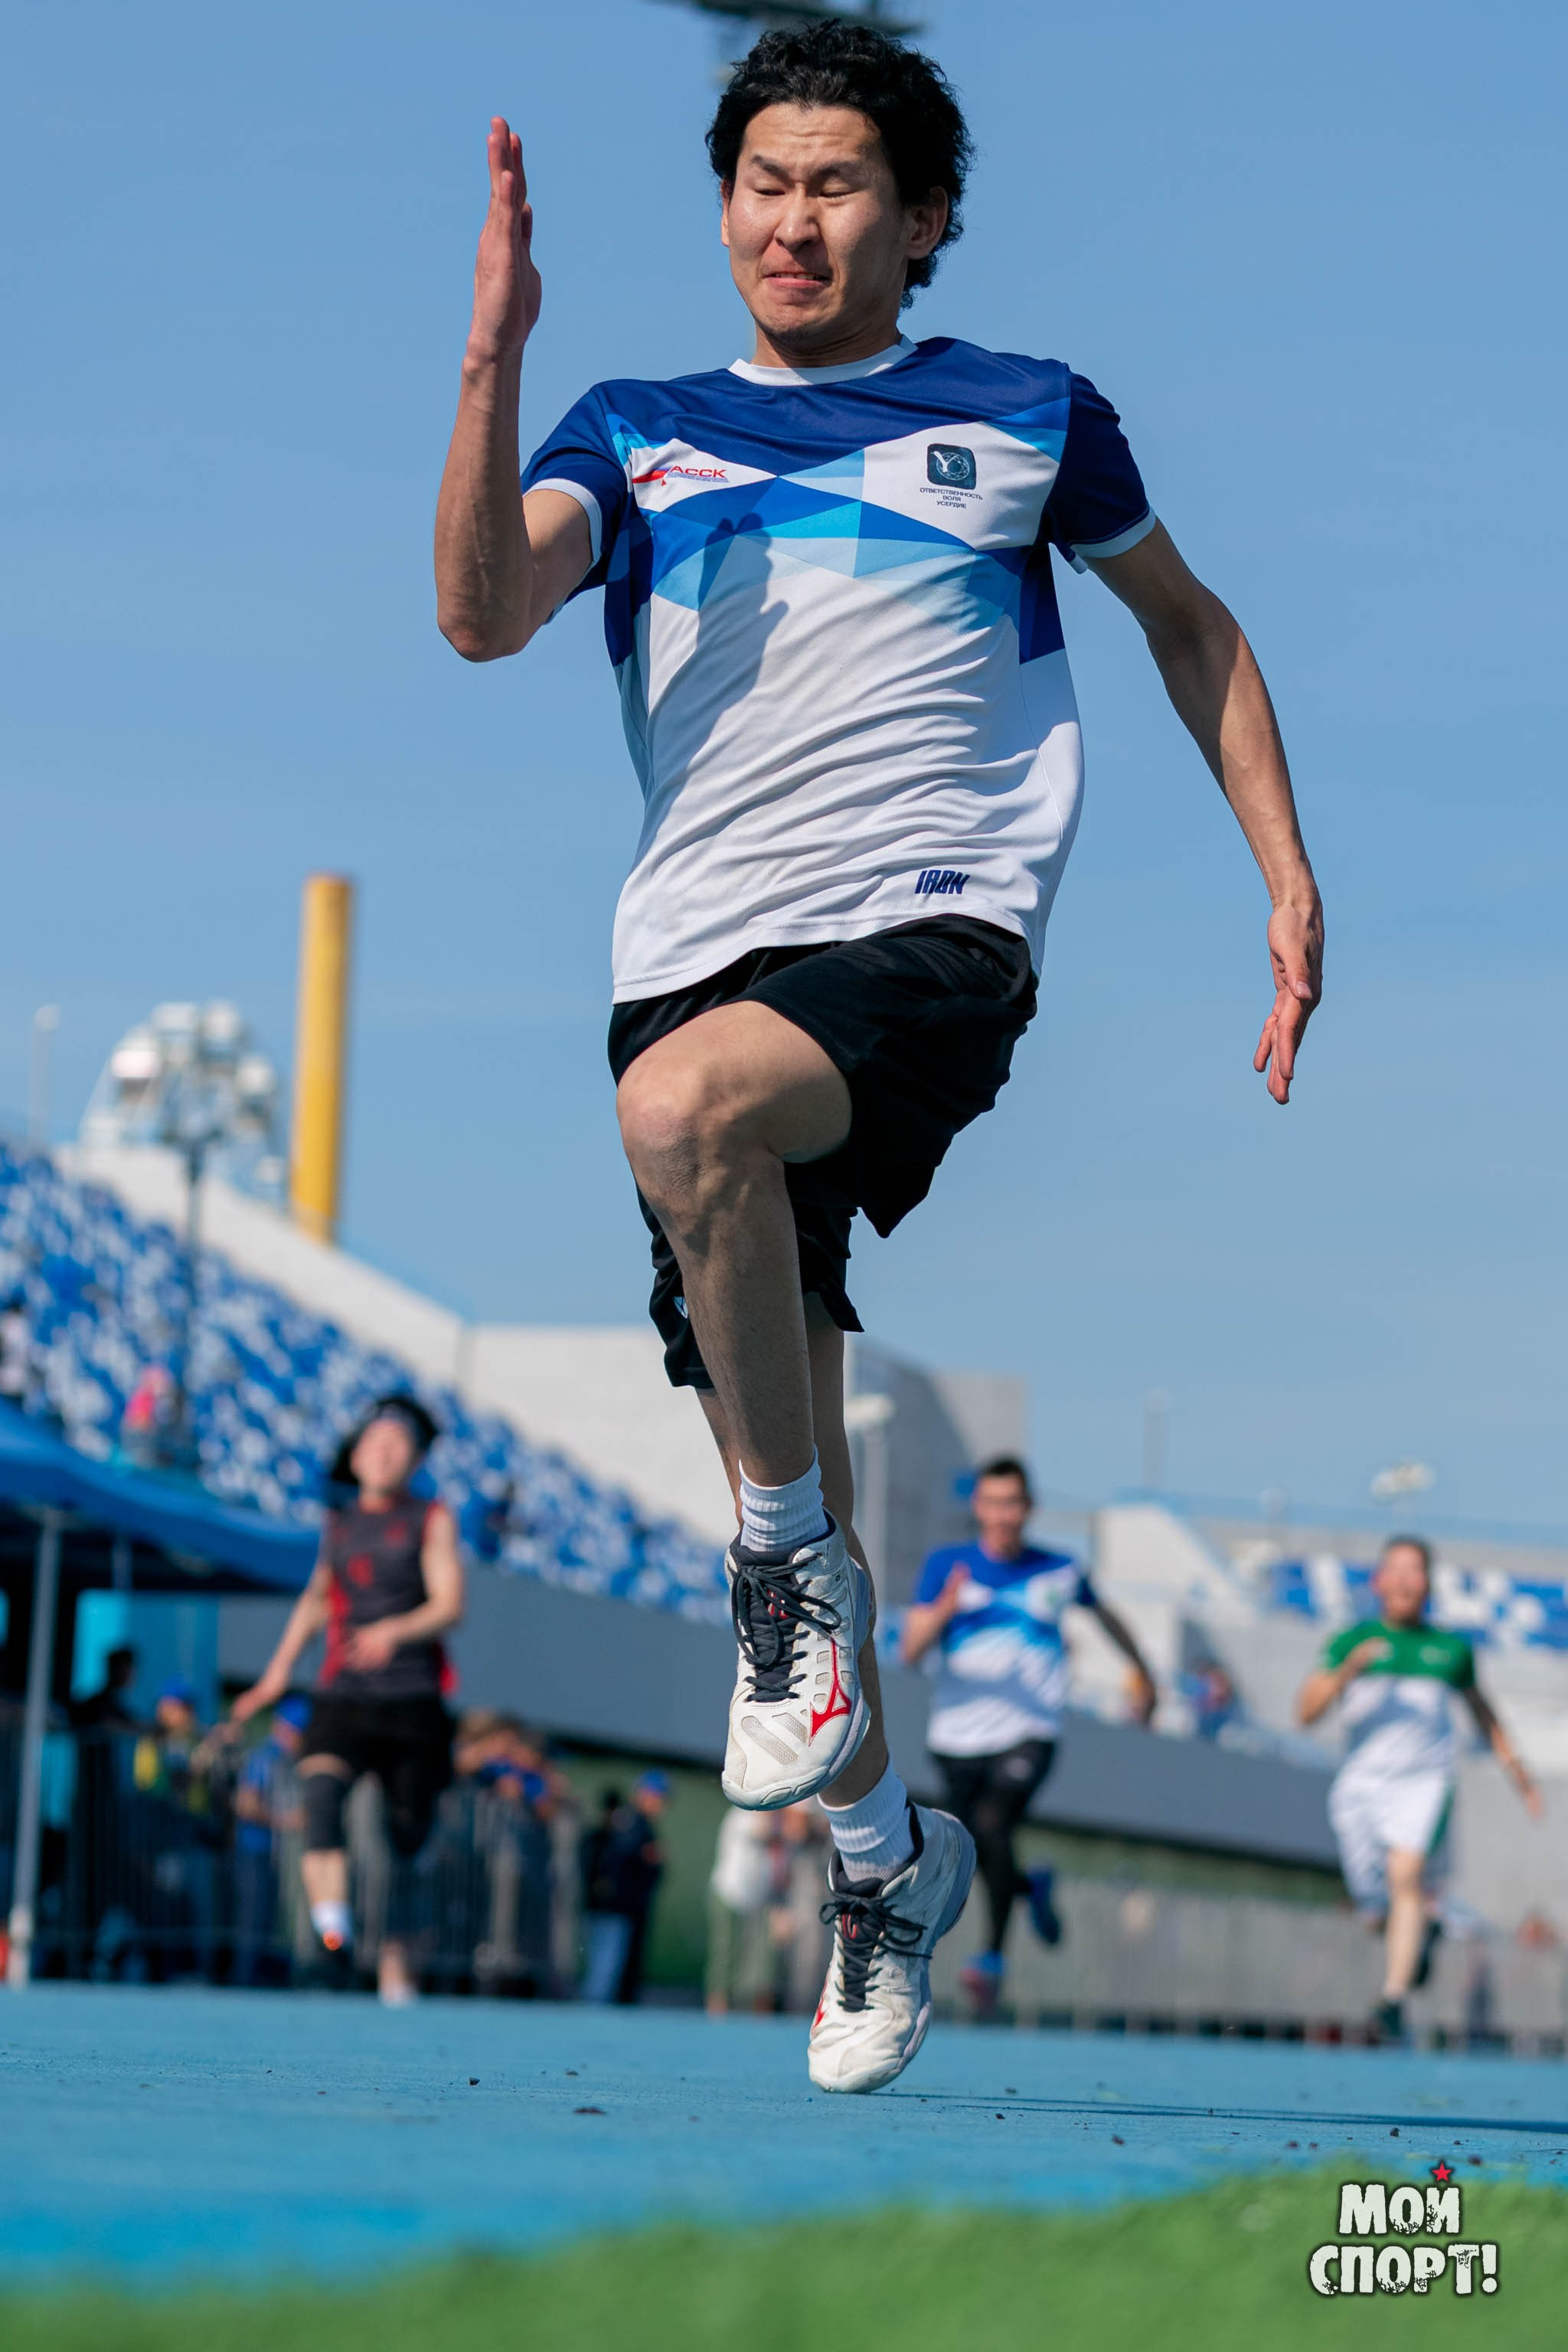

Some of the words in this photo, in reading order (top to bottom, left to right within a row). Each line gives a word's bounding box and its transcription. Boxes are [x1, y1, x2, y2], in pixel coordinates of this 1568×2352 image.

[920, 487, 983, 500] ОТВЕТСТВЕННОСТЬ
[936, 500, 967, 509] УСЕРДИЕ
[915, 869, 971, 894] IRON
